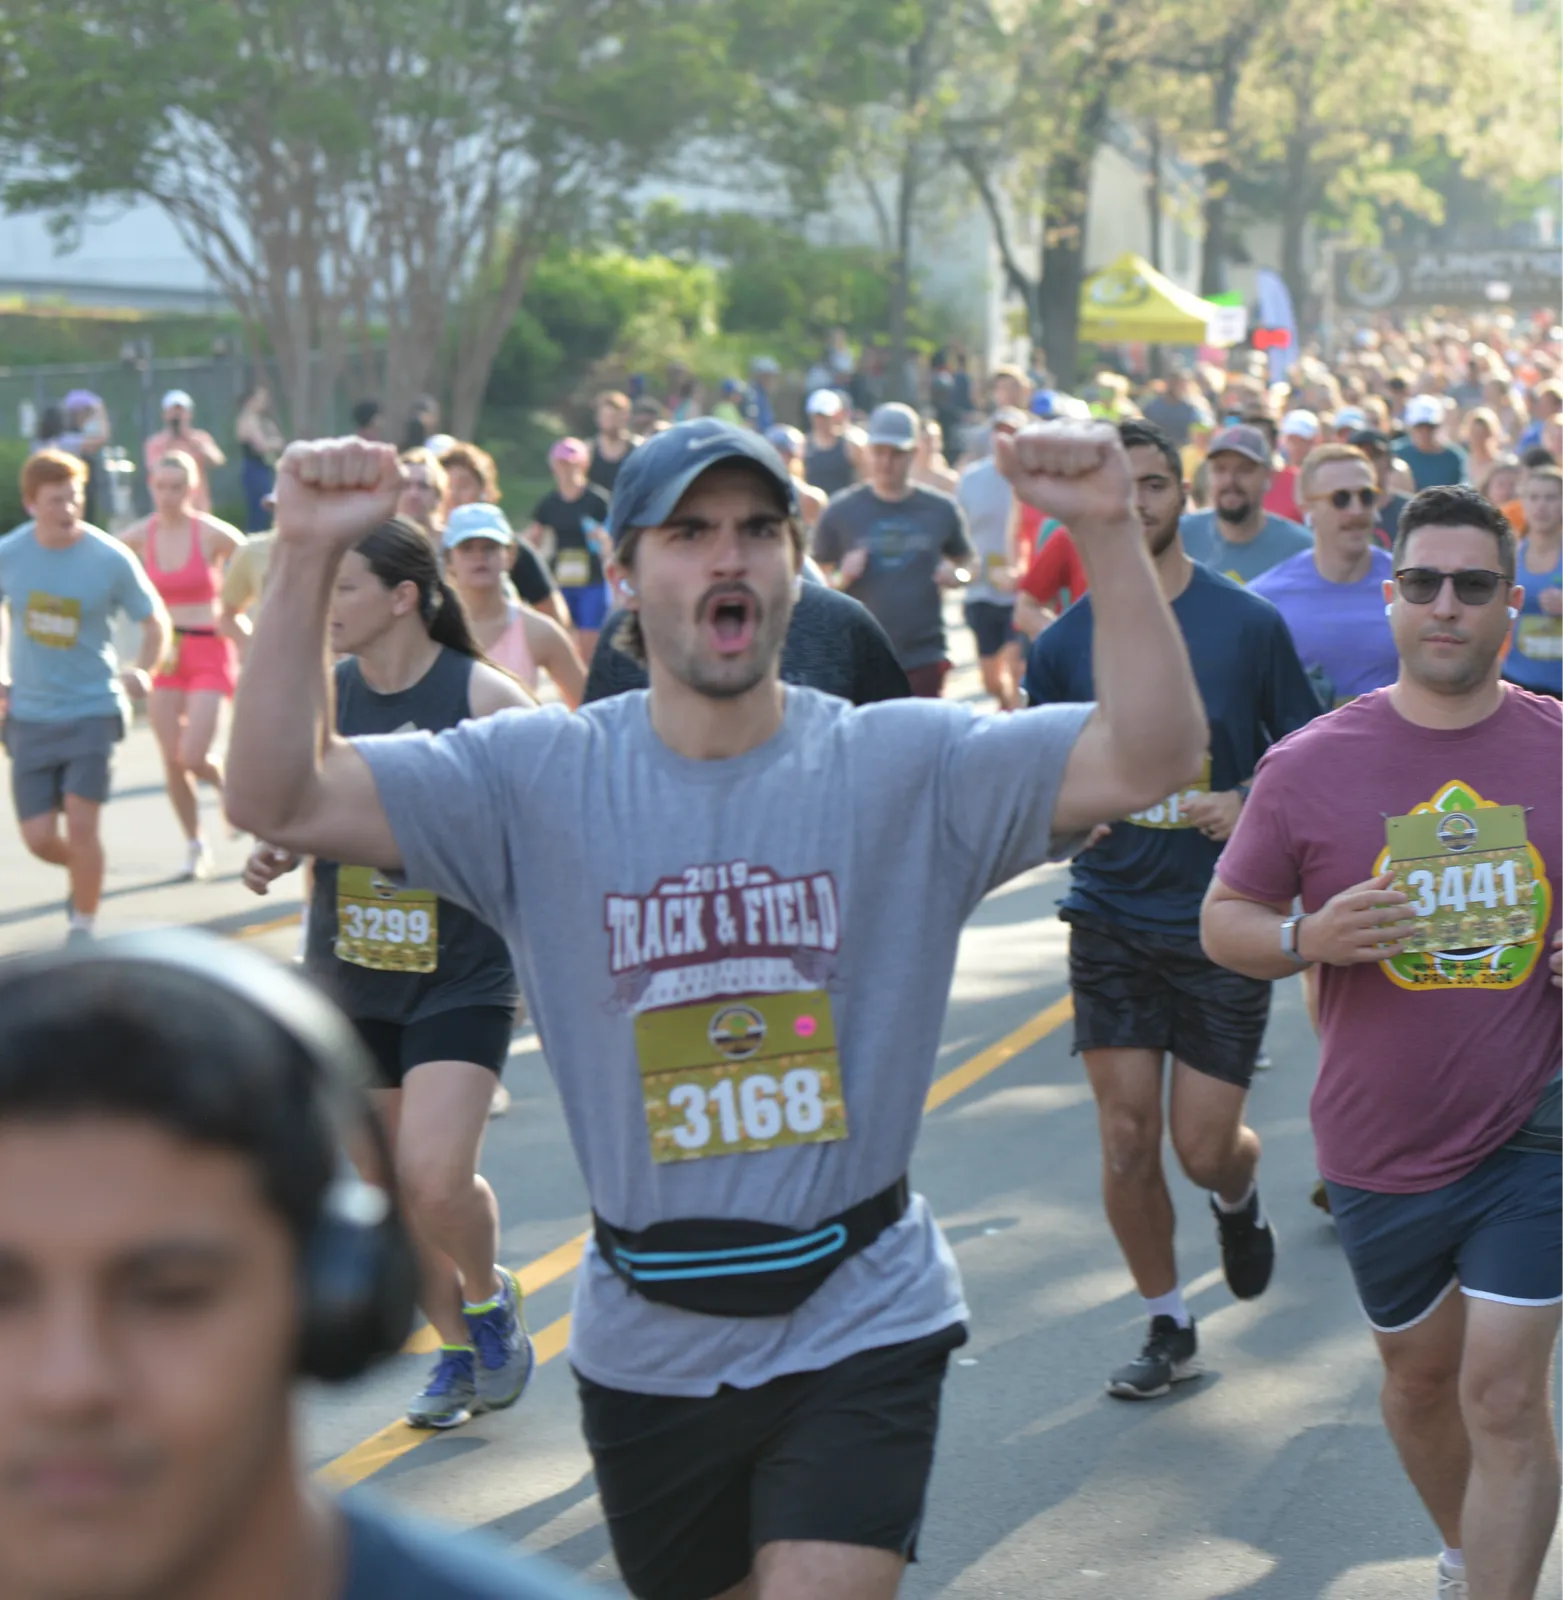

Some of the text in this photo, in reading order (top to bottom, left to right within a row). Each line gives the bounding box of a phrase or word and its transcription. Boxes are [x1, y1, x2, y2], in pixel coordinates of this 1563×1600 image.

[683, 862, 748, 892] 2019
[1407, 860, 1518, 917] 3441
[345, 904, 429, 944] 3299
[607, 874, 839, 971] TRACK & FIELD
[668, 1068, 825, 1150] 3168
